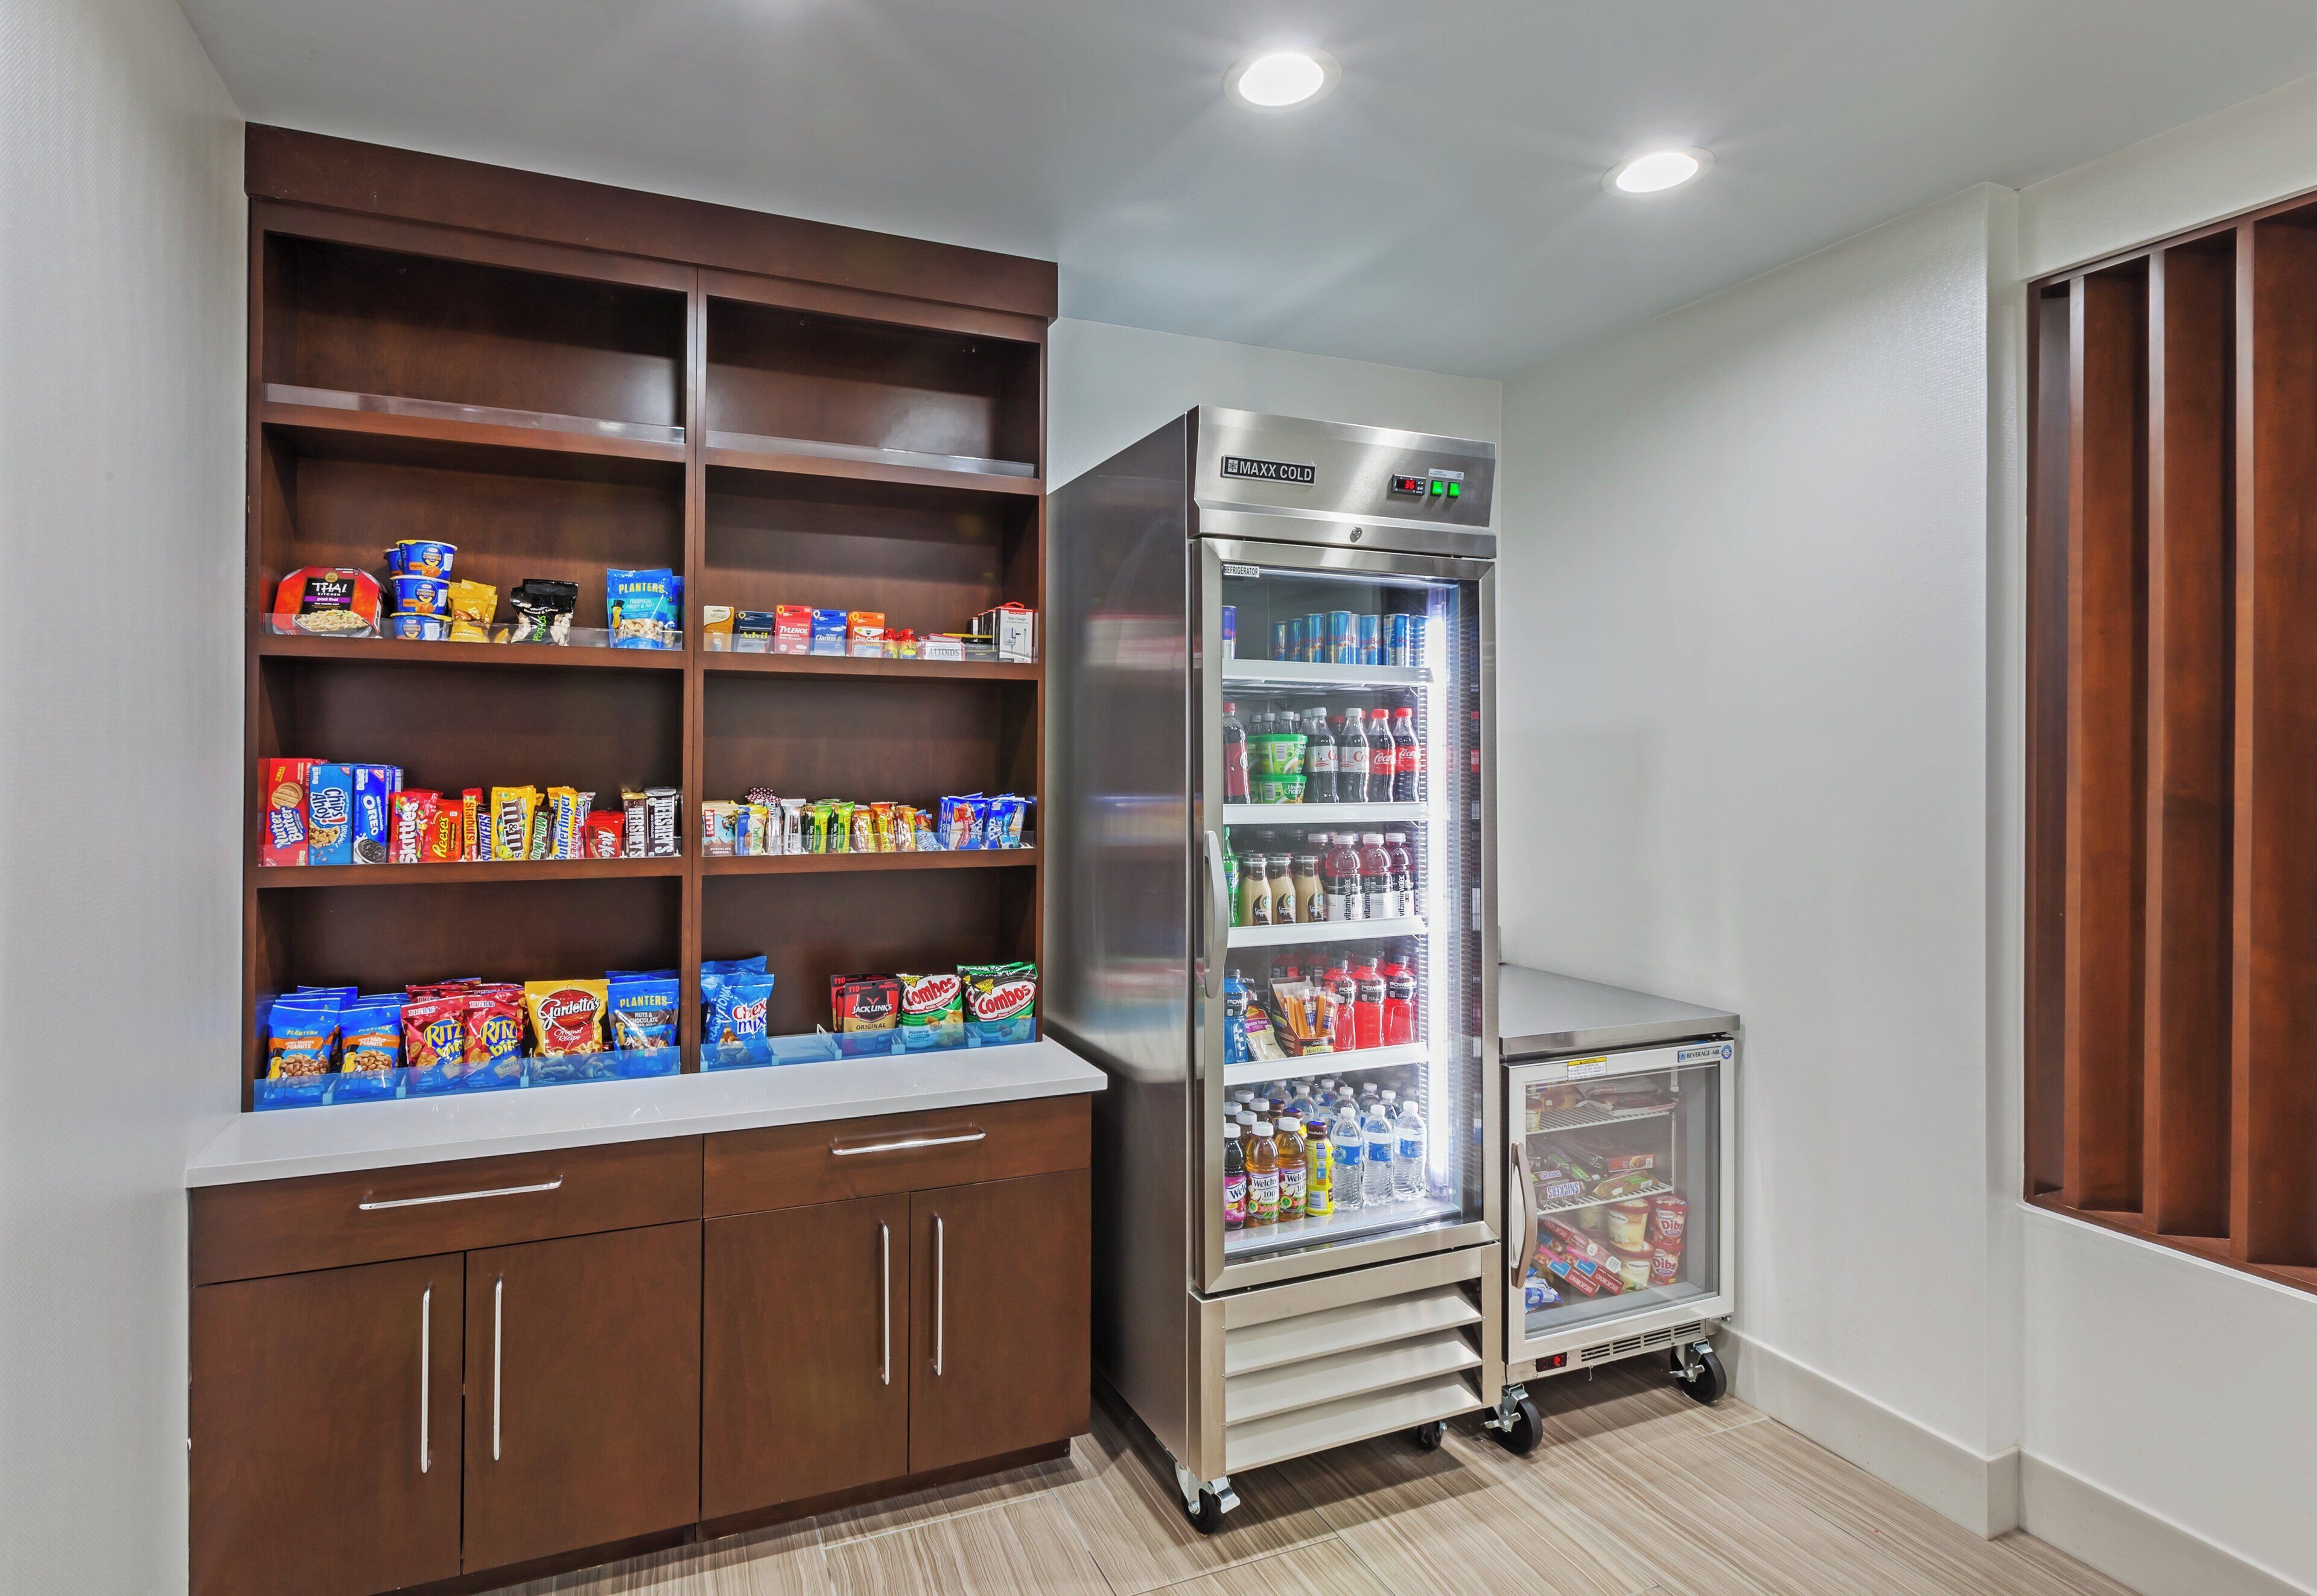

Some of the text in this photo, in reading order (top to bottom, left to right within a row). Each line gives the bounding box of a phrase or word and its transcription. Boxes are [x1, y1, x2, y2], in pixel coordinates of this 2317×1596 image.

[1239, 461, 1312, 481] MAXX COLD
[1405, 480, 1415, 490] 36
[1224, 566, 1259, 576] REFRIGERATOR
[312, 582, 347, 593] THAI
[618, 582, 664, 594] PLANTERS
[780, 626, 808, 634] TYLENOL
[855, 635, 880, 644] DayQuil
[928, 647, 960, 657] ALTOIDS
[323, 788, 345, 818] Chips
[281, 806, 304, 842] Butter
[363, 795, 379, 836] OREO
[465, 802, 475, 841] Starburs
[705, 810, 714, 830] CLIF
[271, 812, 291, 849] Nutter
[399, 802, 420, 863] Skittles
[533, 816, 547, 842] Milky
[554, 795, 573, 860] Butterfinger
[628, 807, 645, 857] HERSHEY'S
[654, 799, 674, 854] HERSHEY'S
[432, 816, 450, 859] Reese's
[753, 827, 761, 851] belVita
[620, 995, 667, 1008] PLANTERS
[905, 978, 956, 1006] Combos
[977, 985, 1031, 1014] Combos
[408, 1006, 436, 1016] BIG BAG
[537, 997, 601, 1031] Gardetto's
[733, 999, 767, 1020] Chex
[852, 1003, 892, 1014] JACK LINK'S
[554, 1026, 583, 1037] Original
[738, 1013, 767, 1032] mix
[427, 1023, 463, 1048] RITZ
[482, 1020, 517, 1048] RITZ
[1253, 1178, 1277, 1188] Welch's
[1540, 1170, 1562, 1180] SNICKERS
[1548, 1182, 1580, 1198] SNICKERS
[1661, 1219, 1684, 1230] Dibs
[1652, 1258, 1678, 1270] Dibs
[1569, 1274, 1594, 1294] DIGIORNO
[1595, 1273, 1619, 1292] DIGIORNO
